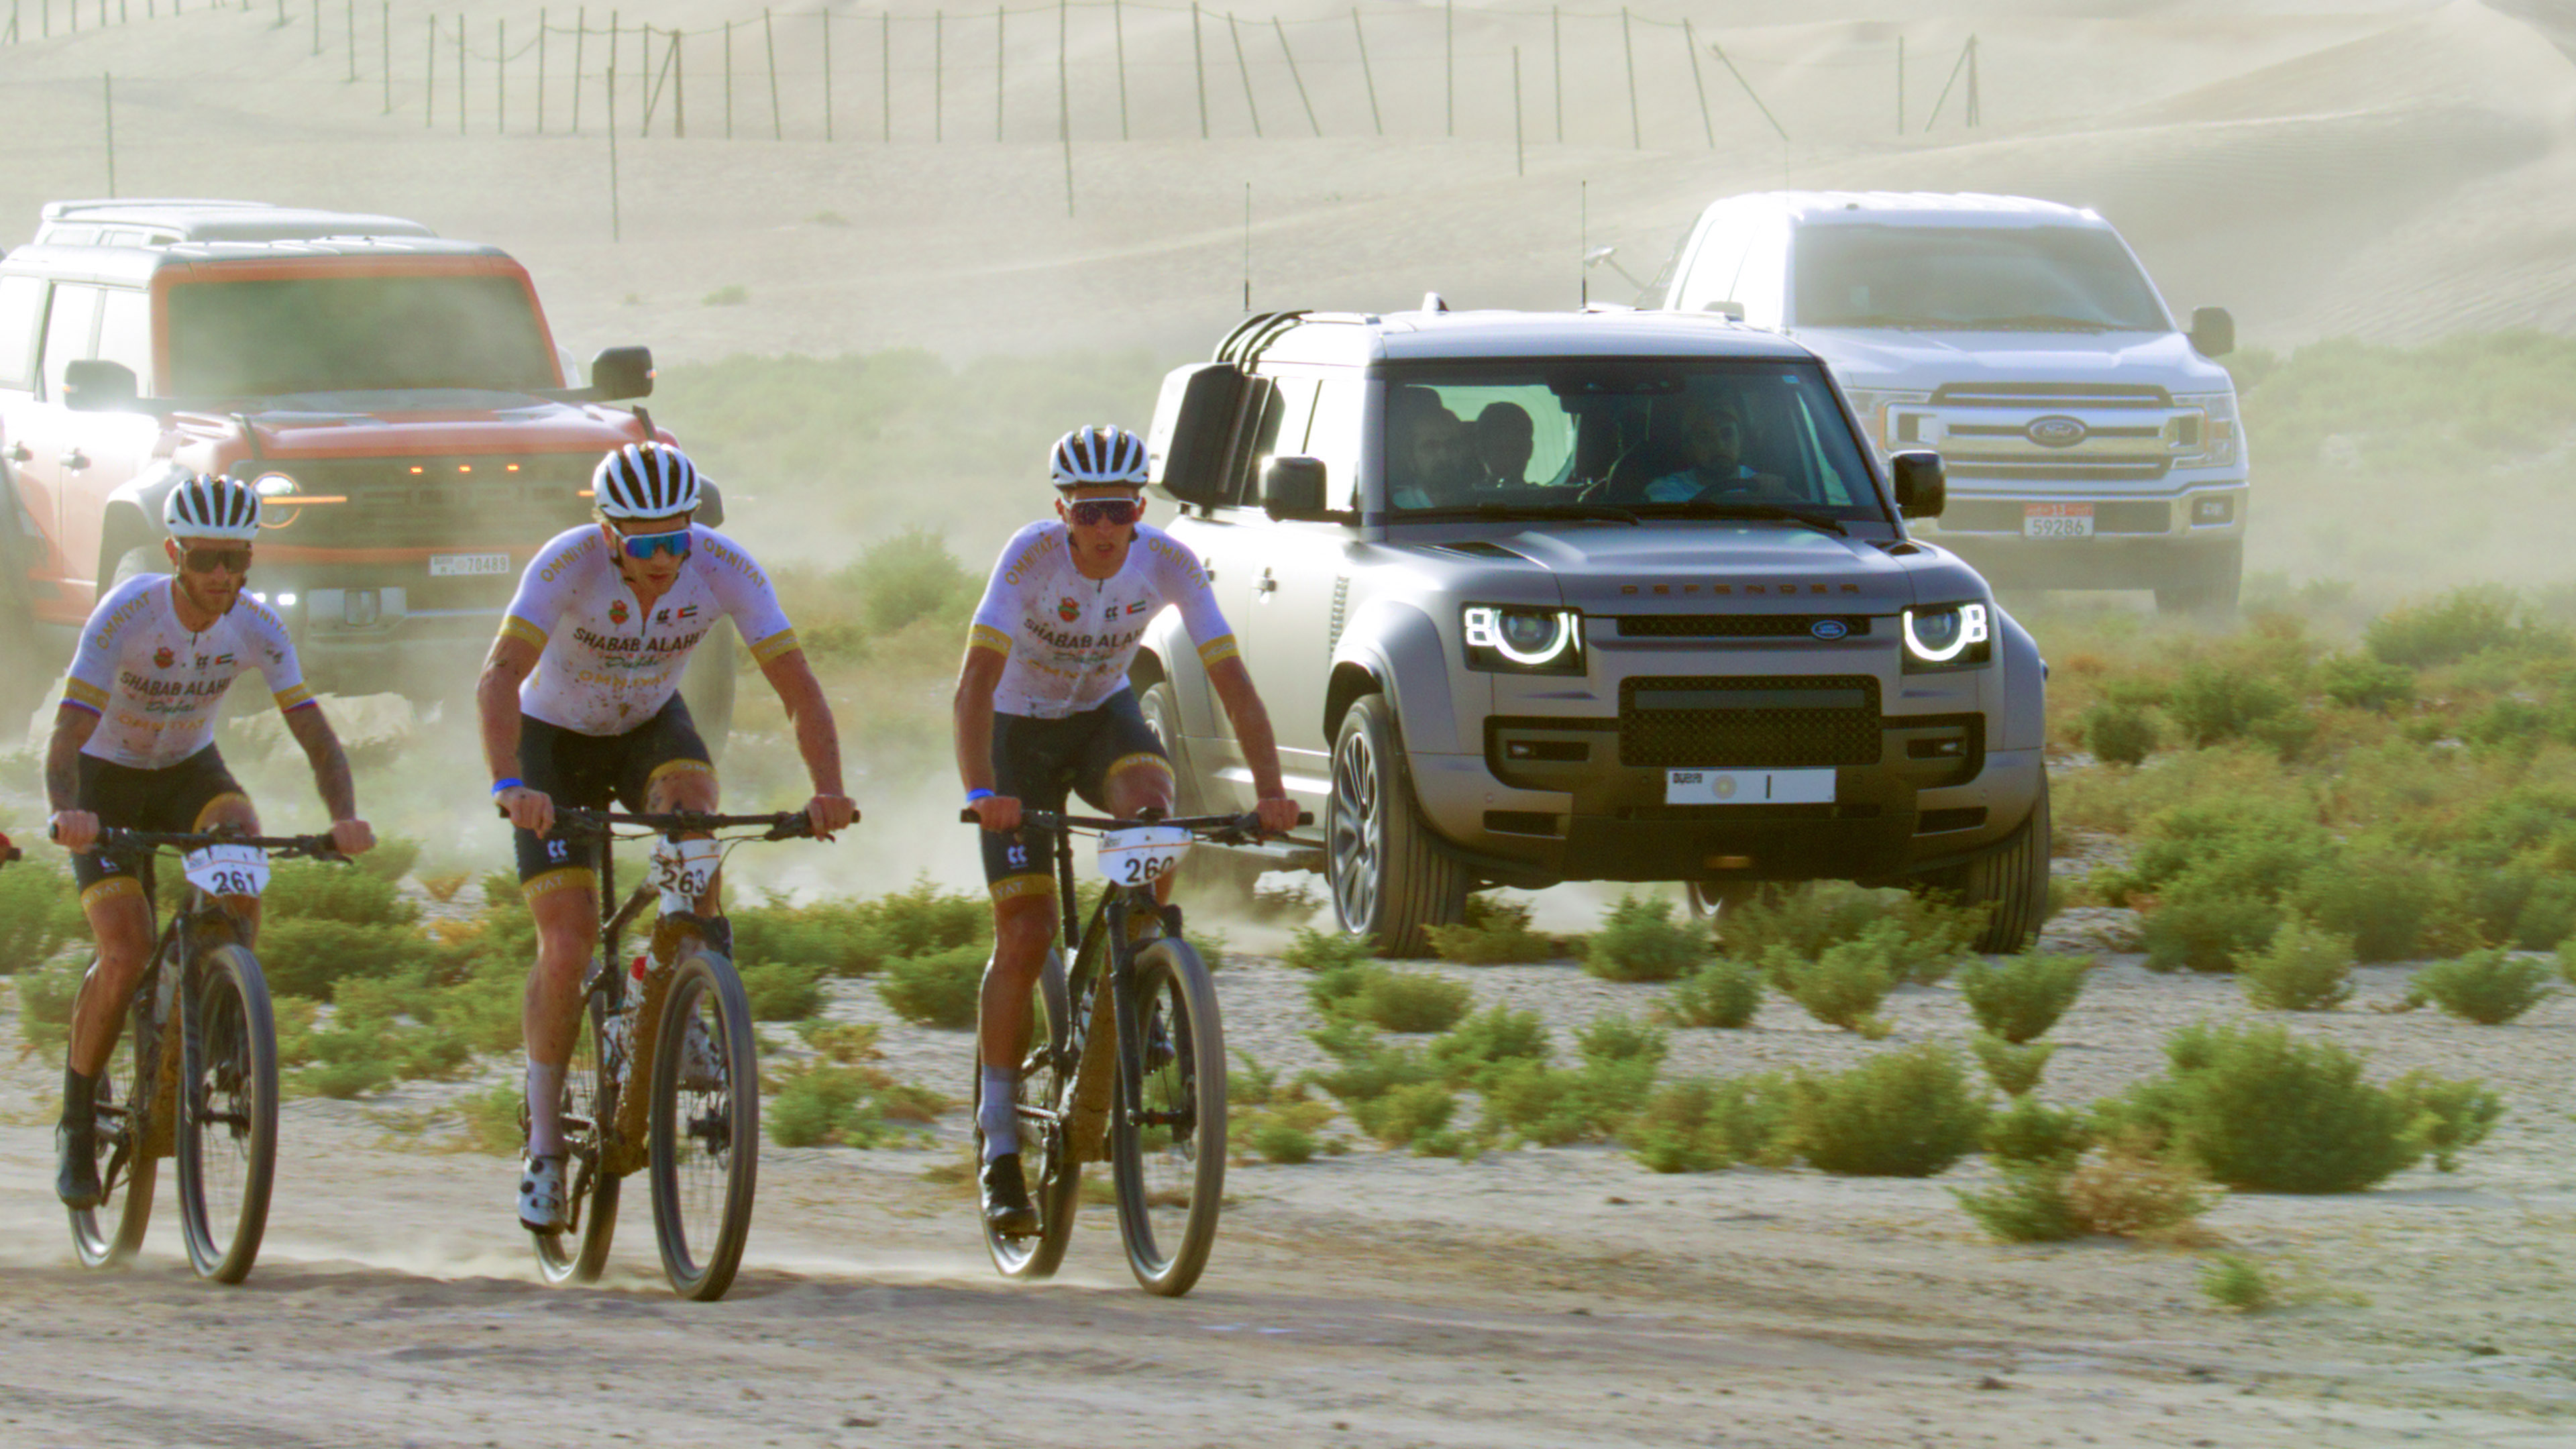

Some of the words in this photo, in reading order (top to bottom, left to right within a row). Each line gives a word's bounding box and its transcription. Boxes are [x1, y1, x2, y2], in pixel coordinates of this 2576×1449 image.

[2033, 519, 2085, 535] 59286
[468, 557, 506, 572] 70489
[541, 536, 596, 582] OMNIYAT
[704, 537, 766, 588] OMNIYAT
[1006, 535, 1053, 586] OMNIYAT
[1148, 537, 1208, 590] OMNIYAT
[1621, 584, 1860, 595] DEFENDER
[97, 590, 150, 650] OMNIYAT
[573, 627, 641, 651] SHABAB
[1024, 618, 1093, 648] SHABAB
[120, 671, 183, 696] SHABAB
[212, 871, 260, 894] 261
[659, 869, 706, 894] 263
